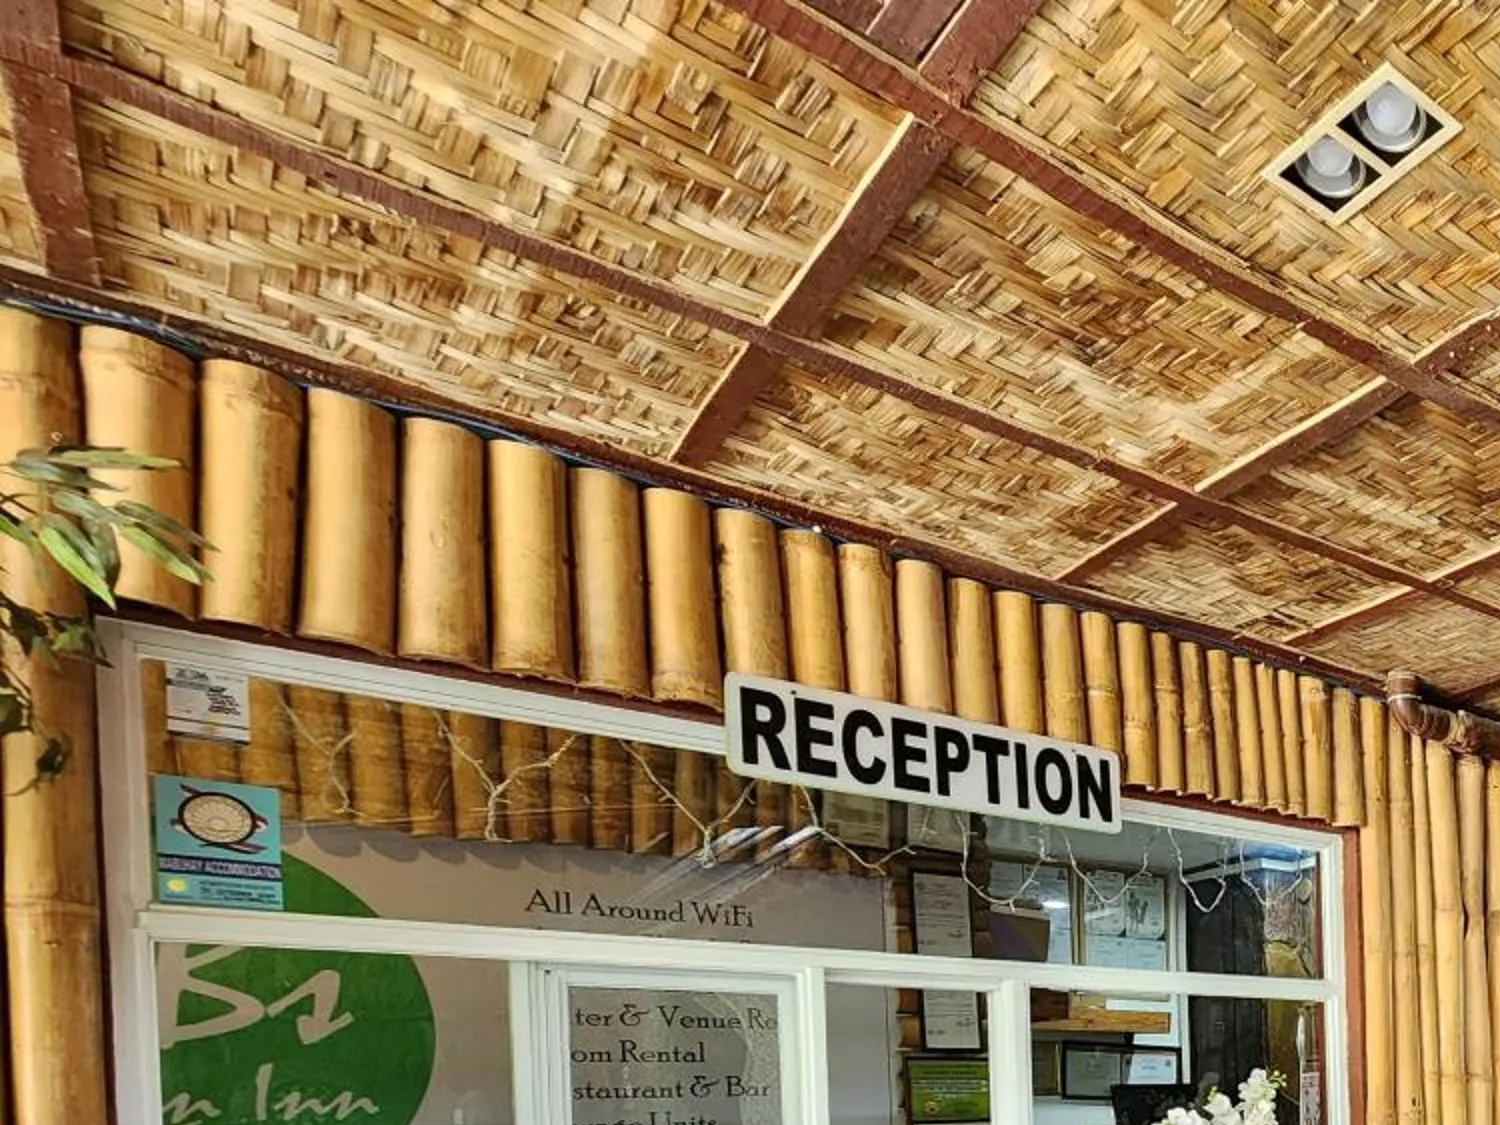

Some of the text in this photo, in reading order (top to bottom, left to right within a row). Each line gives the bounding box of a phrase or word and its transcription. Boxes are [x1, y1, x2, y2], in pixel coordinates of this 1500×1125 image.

[740, 686, 1113, 822] RECEPTION
[525, 888, 754, 928] All Around WiFi
[619, 1004, 649, 1028] &
[657, 1005, 742, 1029] Venue
[619, 1039, 706, 1063] Rental
[255, 1062, 379, 1120] Inn
[573, 1075, 771, 1100] staurant & Bar
